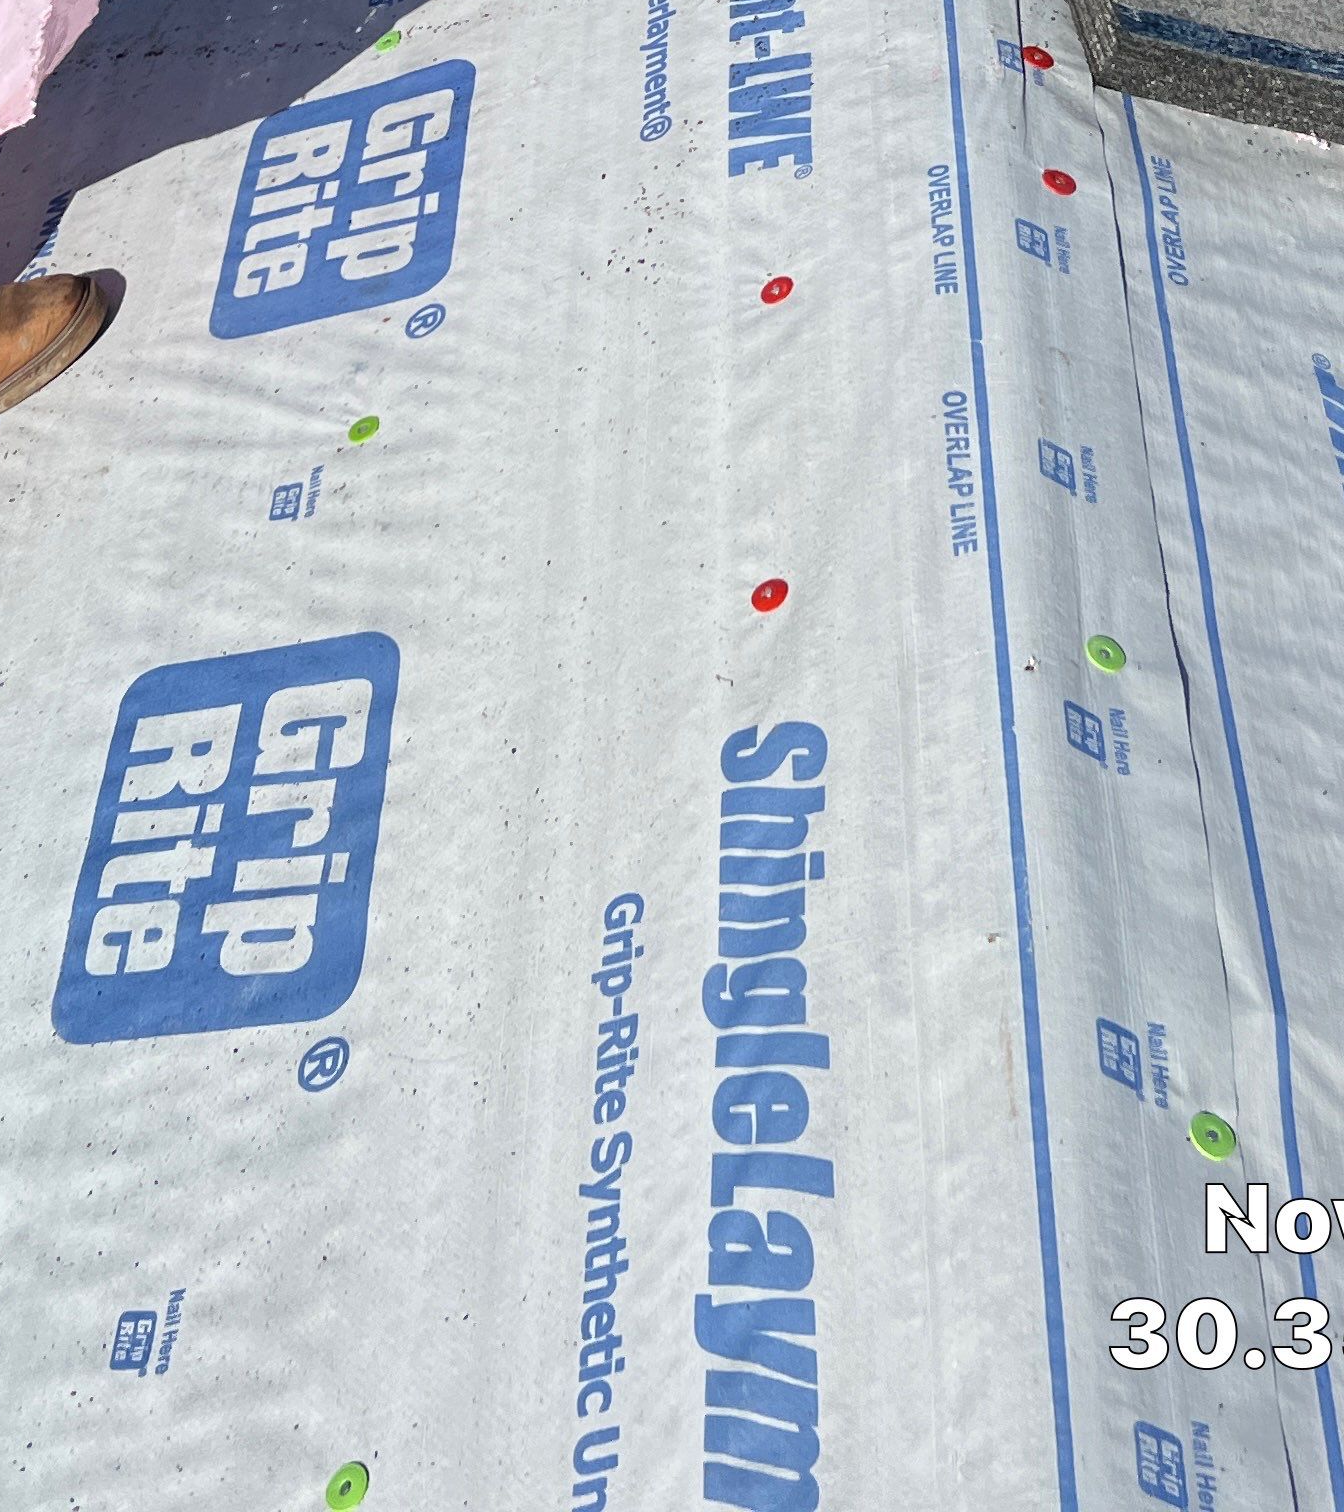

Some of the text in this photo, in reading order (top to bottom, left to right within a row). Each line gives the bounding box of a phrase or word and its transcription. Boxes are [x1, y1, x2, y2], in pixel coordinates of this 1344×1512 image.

[232, 116, 354, 300] Rite
[325, 88, 456, 283] Grip
[927, 164, 960, 296] OVERLAP LINE
[1150, 154, 1191, 287] OVERLAP LINE
[941, 389, 979, 557] OVERLAP LINE
[1108, 707, 1131, 776] Nail Here
[83, 701, 244, 979] Rite
[200, 677, 374, 979] Grip
[590, 892, 646, 1127] Grip-Rite
[1147, 1019, 1170, 1110] Nail Here
[130, 1318, 153, 1362] Grip
[154, 1287, 187, 1375] Nail Here
[576, 1128, 634, 1419] Synthetic
[114, 1320, 136, 1361] Rite
[1191, 1420, 1215, 1468] Nail
